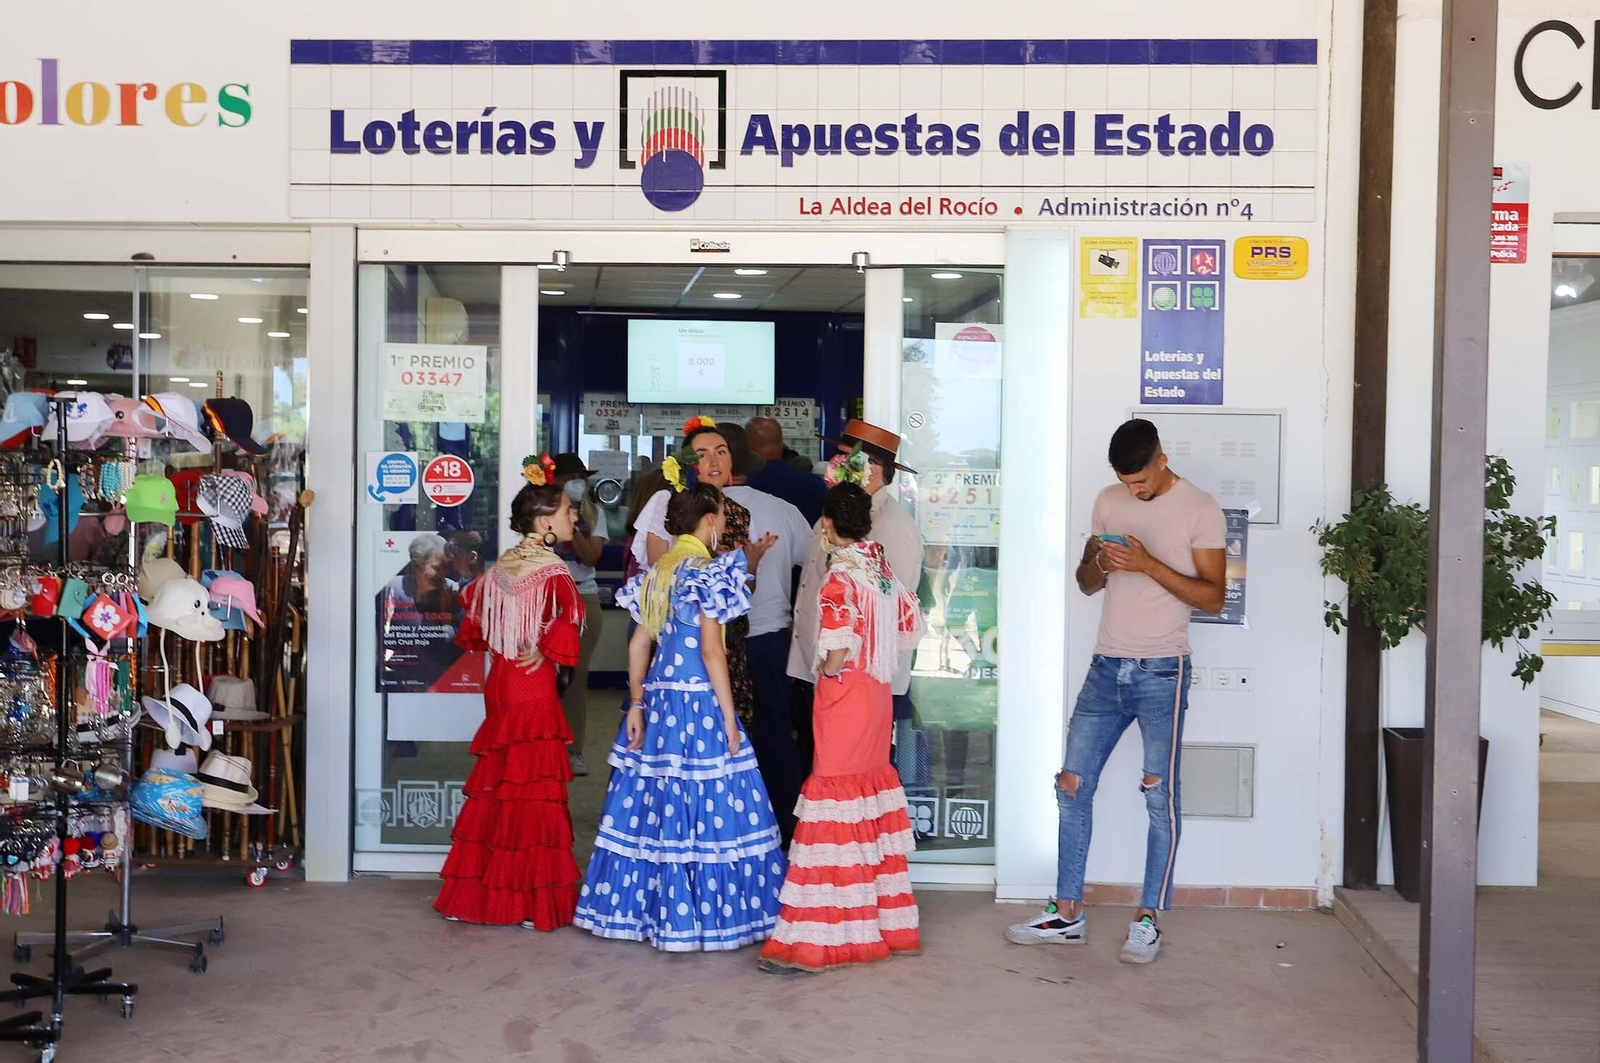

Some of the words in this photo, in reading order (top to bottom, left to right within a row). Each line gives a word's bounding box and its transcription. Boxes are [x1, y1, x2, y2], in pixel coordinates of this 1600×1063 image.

[1514, 20, 1600, 110] C
[330, 106, 556, 155] Loterías
[571, 121, 606, 168] y
[740, 113, 982, 168] Apuestas
[999, 111, 1075, 157] del
[1093, 111, 1275, 157] Estado
[799, 197, 822, 215] La
[829, 196, 892, 215] Aldea
[899, 196, 932, 215] del
[939, 196, 998, 215] Rocío
[1038, 197, 1208, 217] Administración
[1251, 246, 1291, 258] PRS
[410, 355, 475, 369] PREMIO
[1196, 353, 1205, 365] y
[401, 371, 463, 387] 03347
[1144, 368, 1200, 382] Apuestas
[1202, 367, 1222, 380] del
[1144, 386, 1186, 398] Estado
[596, 409, 629, 417] 03347
[433, 461, 461, 478] +18
